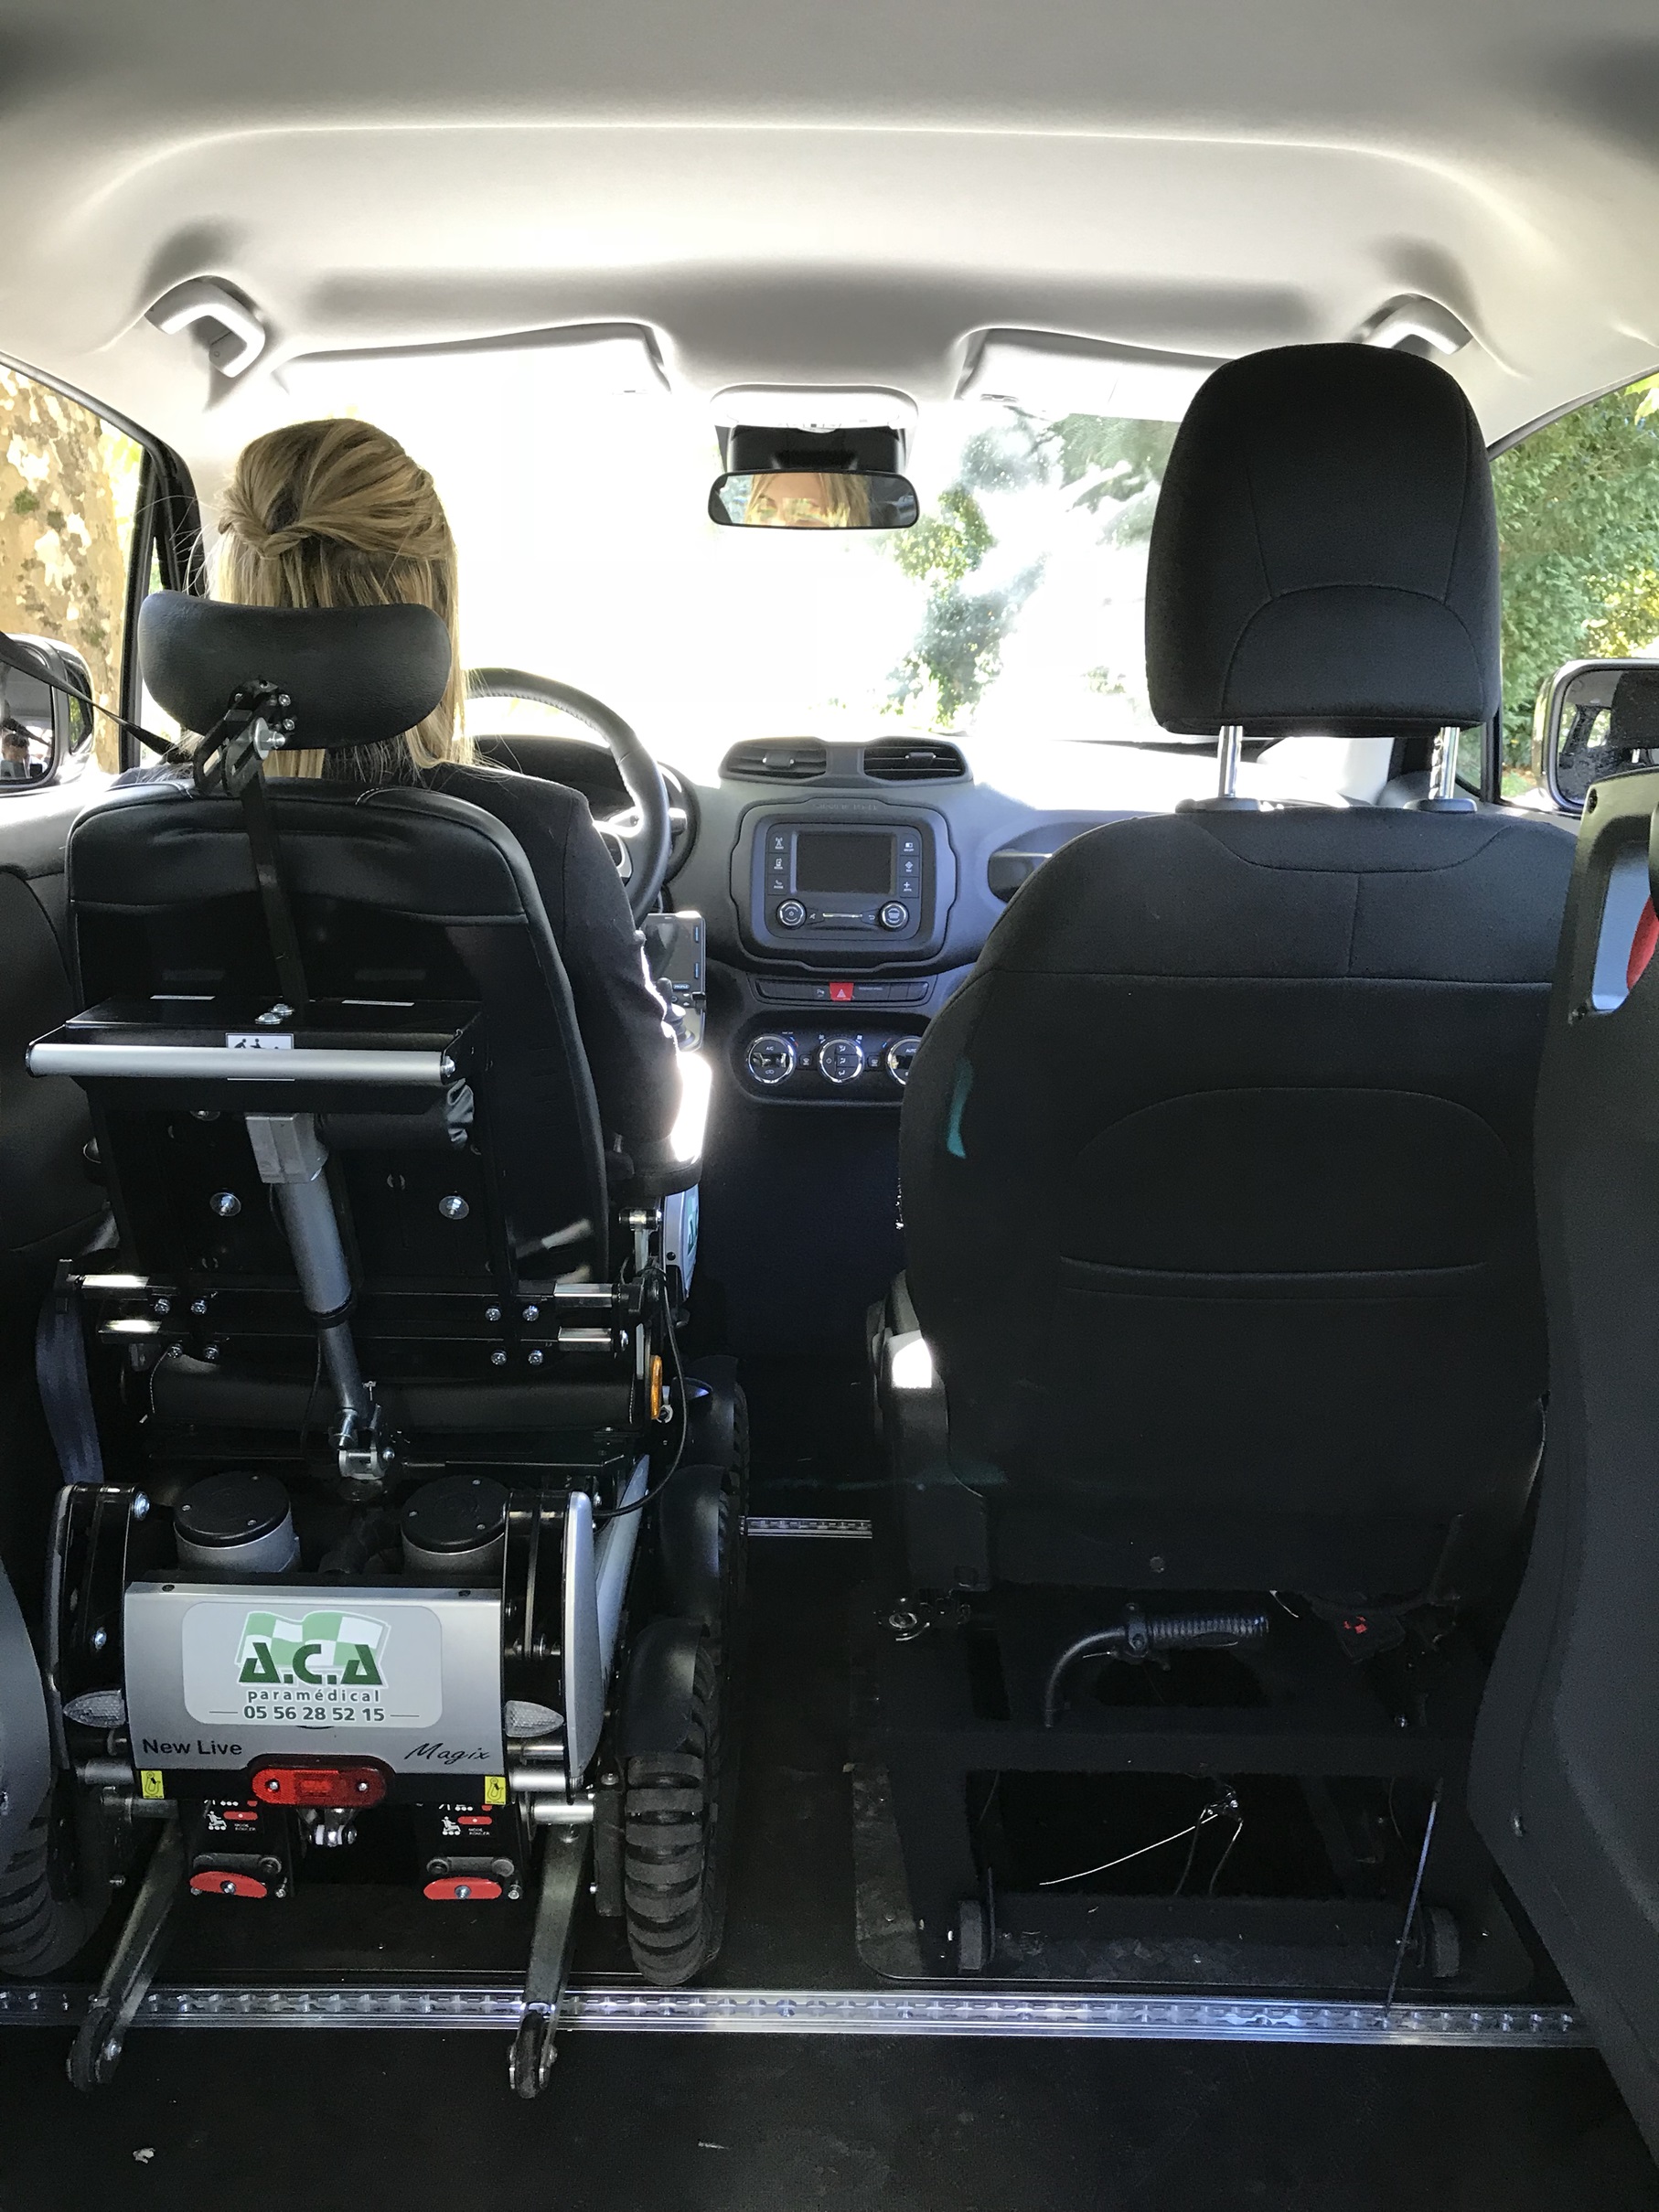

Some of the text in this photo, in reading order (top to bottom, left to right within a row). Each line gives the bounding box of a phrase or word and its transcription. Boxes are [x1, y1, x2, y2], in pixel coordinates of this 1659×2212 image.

[239, 1642, 382, 1685] A.C.A
[248, 1689, 380, 1703] paramédical
[244, 1705, 385, 1722] 05 56 28 52 15
[143, 1739, 242, 1755] New Live
[404, 1742, 489, 1765] Magix
